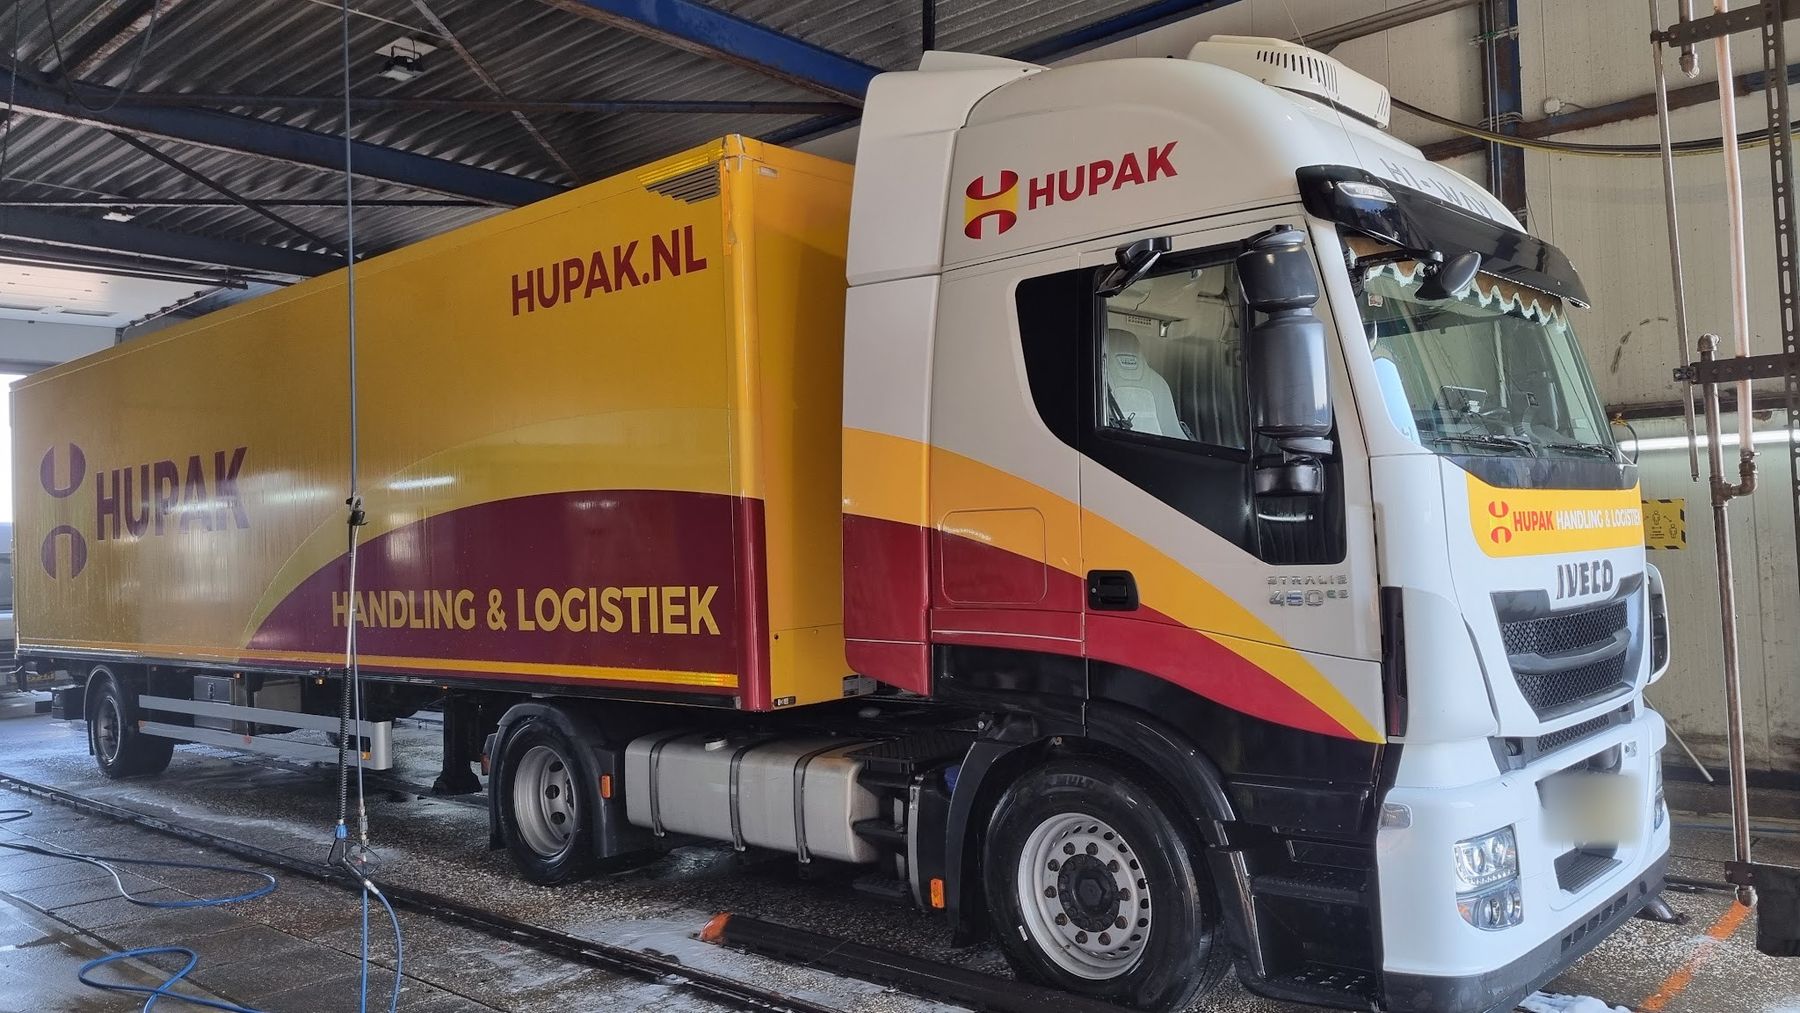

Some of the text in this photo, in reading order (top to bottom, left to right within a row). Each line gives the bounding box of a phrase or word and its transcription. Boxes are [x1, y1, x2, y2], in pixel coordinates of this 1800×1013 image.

[1028, 140, 1179, 210] HUPAK
[511, 224, 707, 317] HUPAK.NL
[96, 446, 250, 541] HUPAK
[1513, 510, 1554, 532] HUPAK
[1556, 508, 1604, 531] HANDLING
[1605, 508, 1611, 528] &
[1266, 574, 1348, 585] STRALIS
[1556, 559, 1614, 600] IVECO
[331, 585, 721, 635] HANDLING & LOGISTIEK
